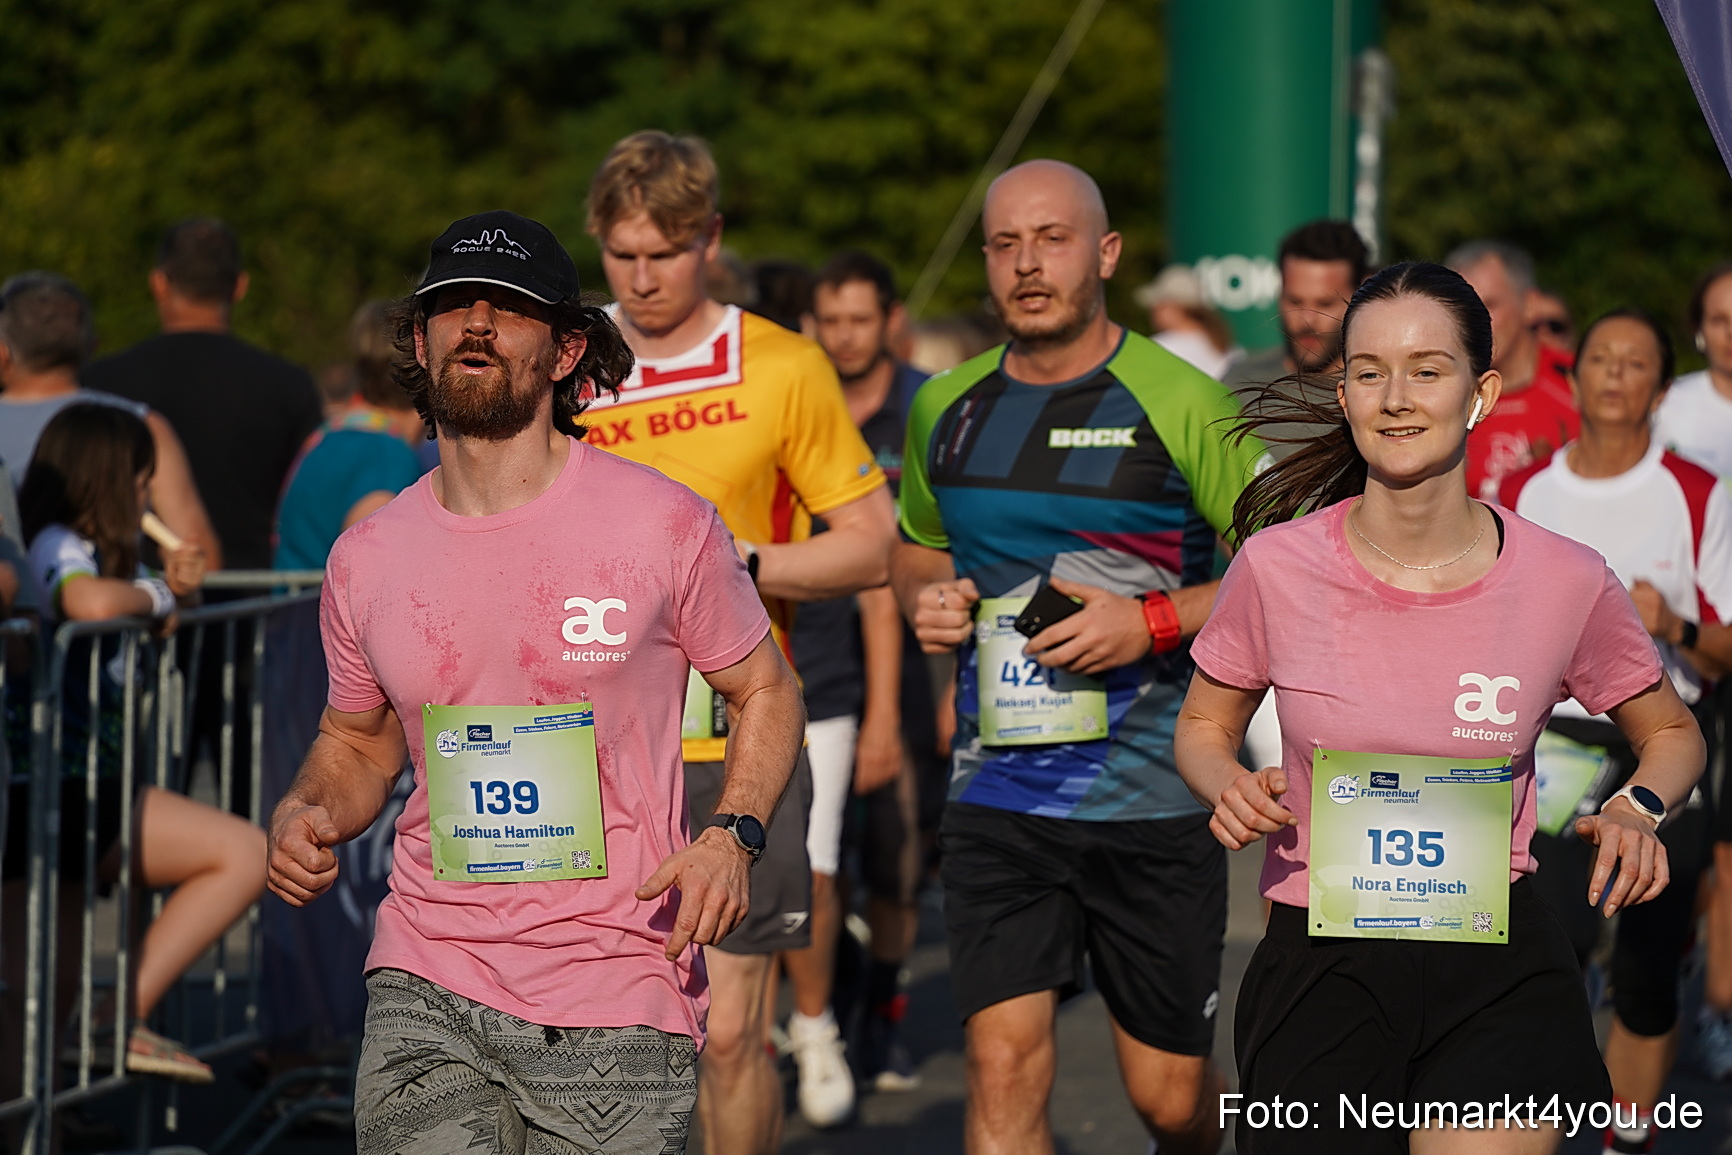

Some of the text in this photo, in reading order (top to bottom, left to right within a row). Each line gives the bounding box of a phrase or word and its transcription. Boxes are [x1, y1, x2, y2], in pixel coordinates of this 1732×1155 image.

[588, 400, 747, 447] AX BÖGL
[1049, 428, 1138, 447] BOCK
[562, 597, 627, 645] ac
[562, 650, 628, 662] auctores
[1454, 672, 1521, 726] ac
[1452, 726, 1515, 742] auctores
[461, 740, 512, 751] Firmenlauf
[470, 780, 540, 815] 139
[1361, 788, 1421, 799] Firmenlauf
[453, 825, 575, 839] Joshua Hamilton
[1367, 829, 1445, 868] 135
[469, 864, 521, 873] firmenlauf.bayern
[1352, 876, 1467, 896] Nora Englisch
[1357, 919, 1418, 928] firmenlauf.bayern
